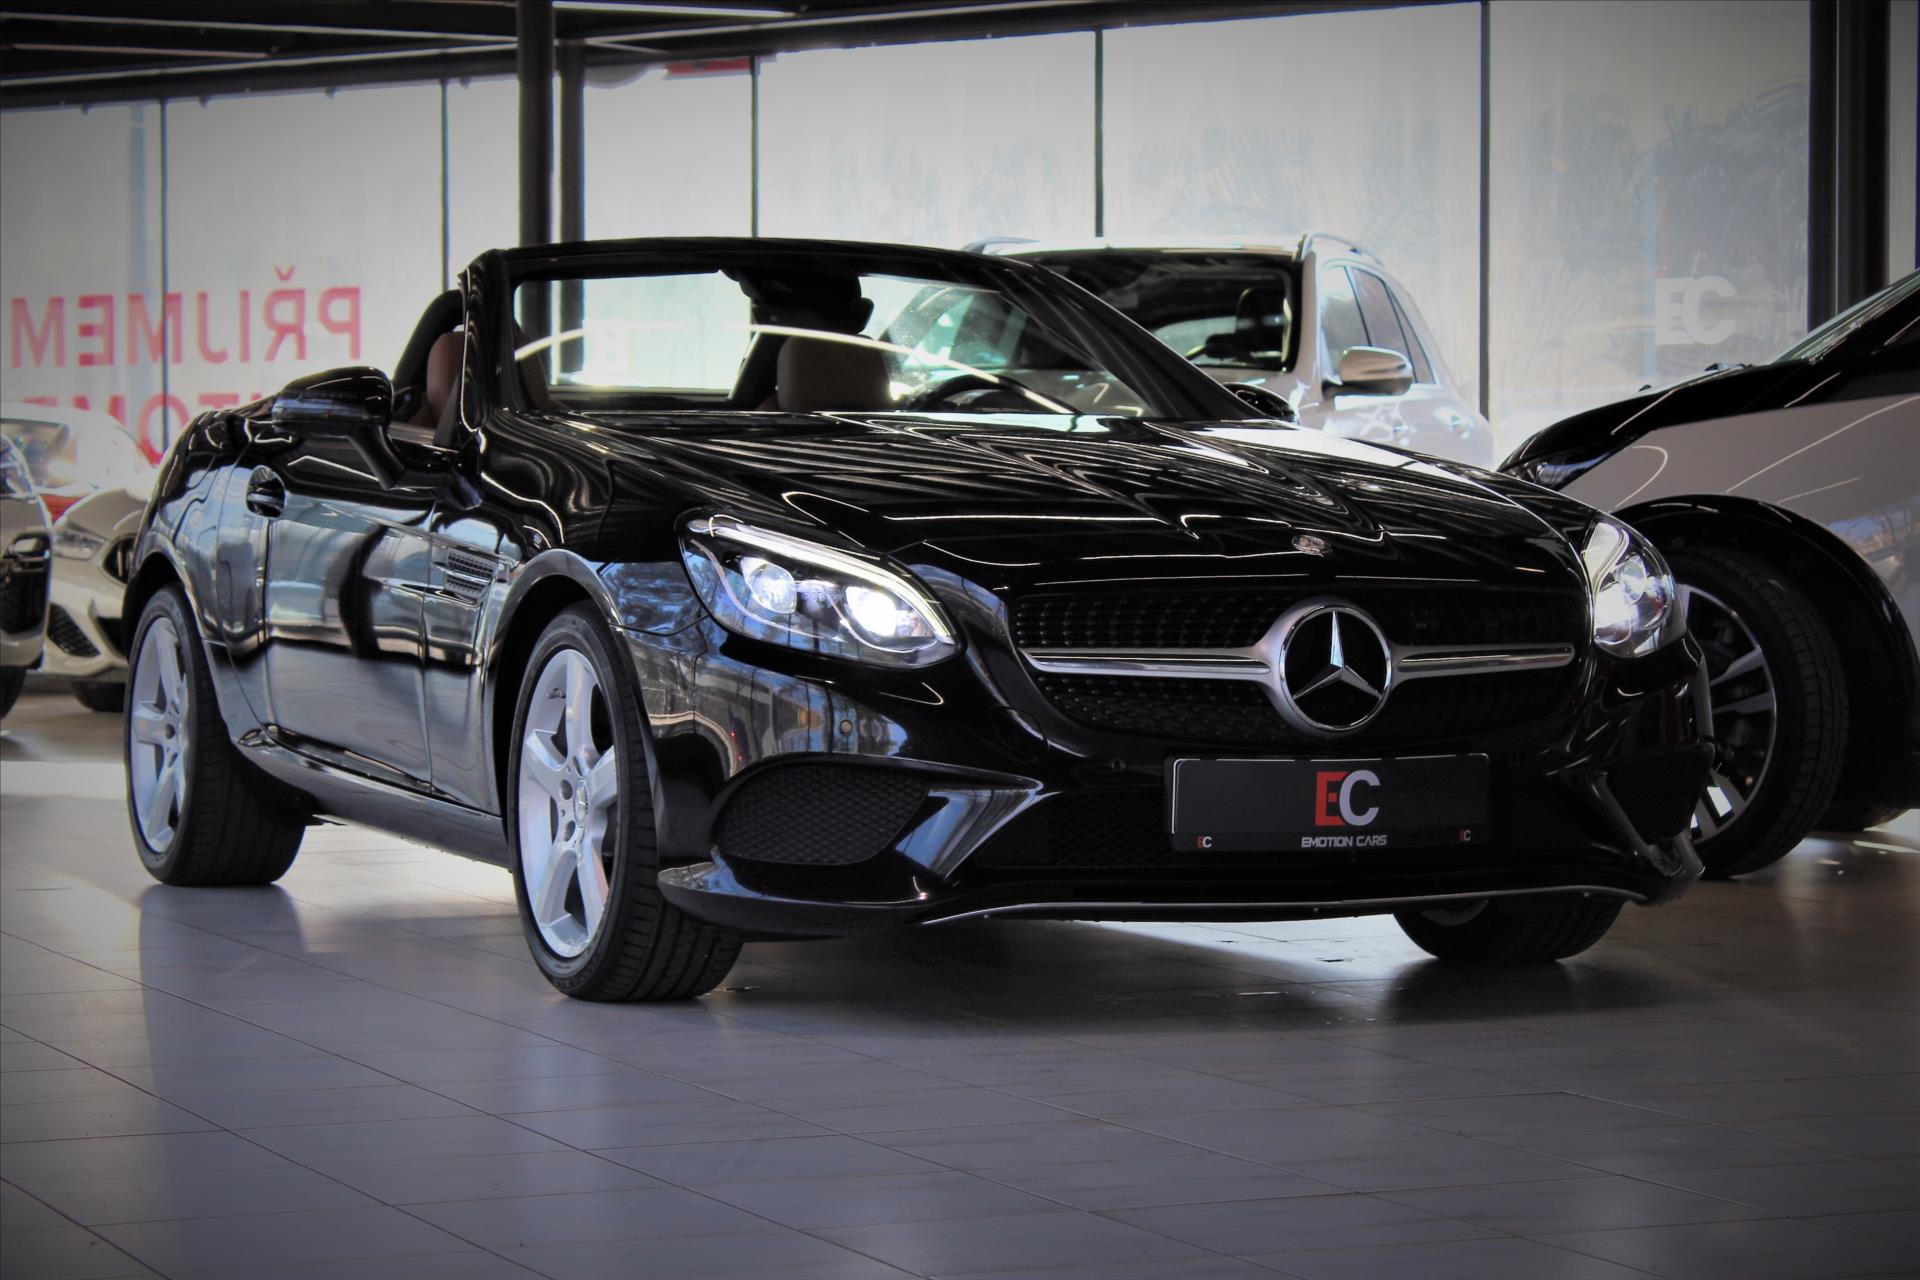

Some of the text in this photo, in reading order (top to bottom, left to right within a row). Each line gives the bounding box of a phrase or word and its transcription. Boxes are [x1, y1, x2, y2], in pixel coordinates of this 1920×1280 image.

[1655, 275, 1737, 346] EC
[1314, 769, 1380, 826] EC
[1197, 835, 1213, 848] EC
[1301, 834, 1388, 848] EMOTION CARS
